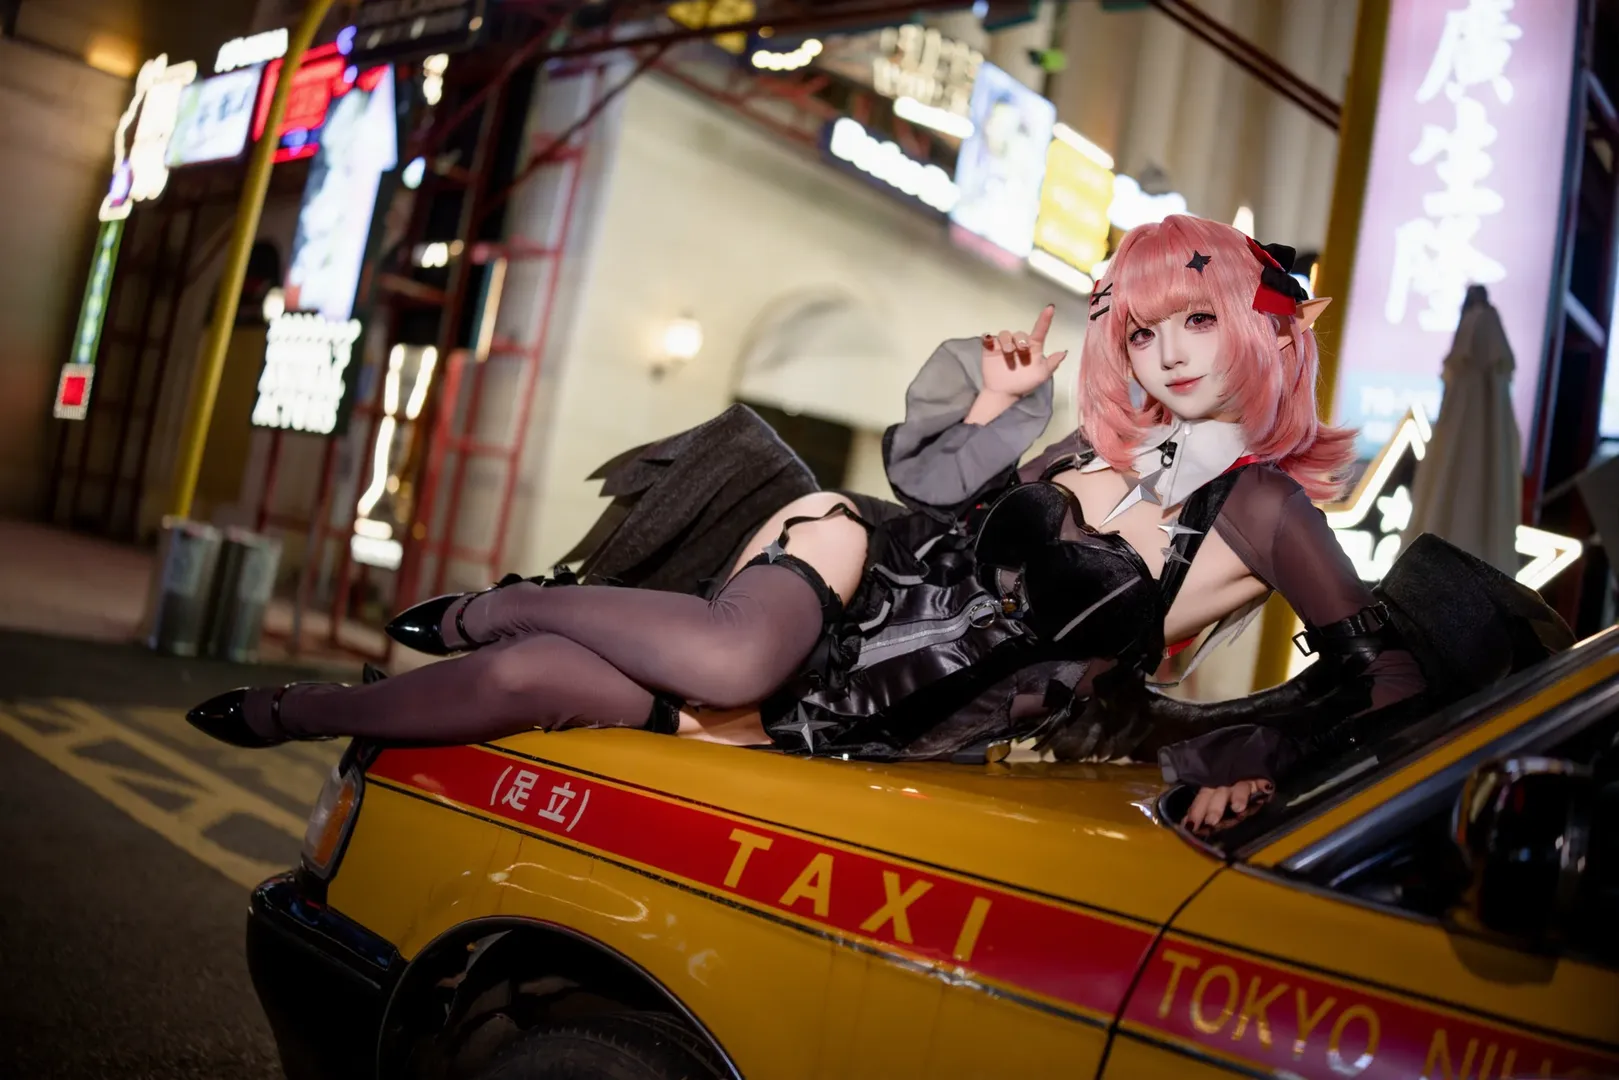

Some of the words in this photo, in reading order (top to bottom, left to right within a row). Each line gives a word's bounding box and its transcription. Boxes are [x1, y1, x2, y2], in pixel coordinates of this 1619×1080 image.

[490, 765, 590, 832] (足立)
[723, 828, 992, 962] TAXI
[1158, 951, 1380, 1076] TOKYO
